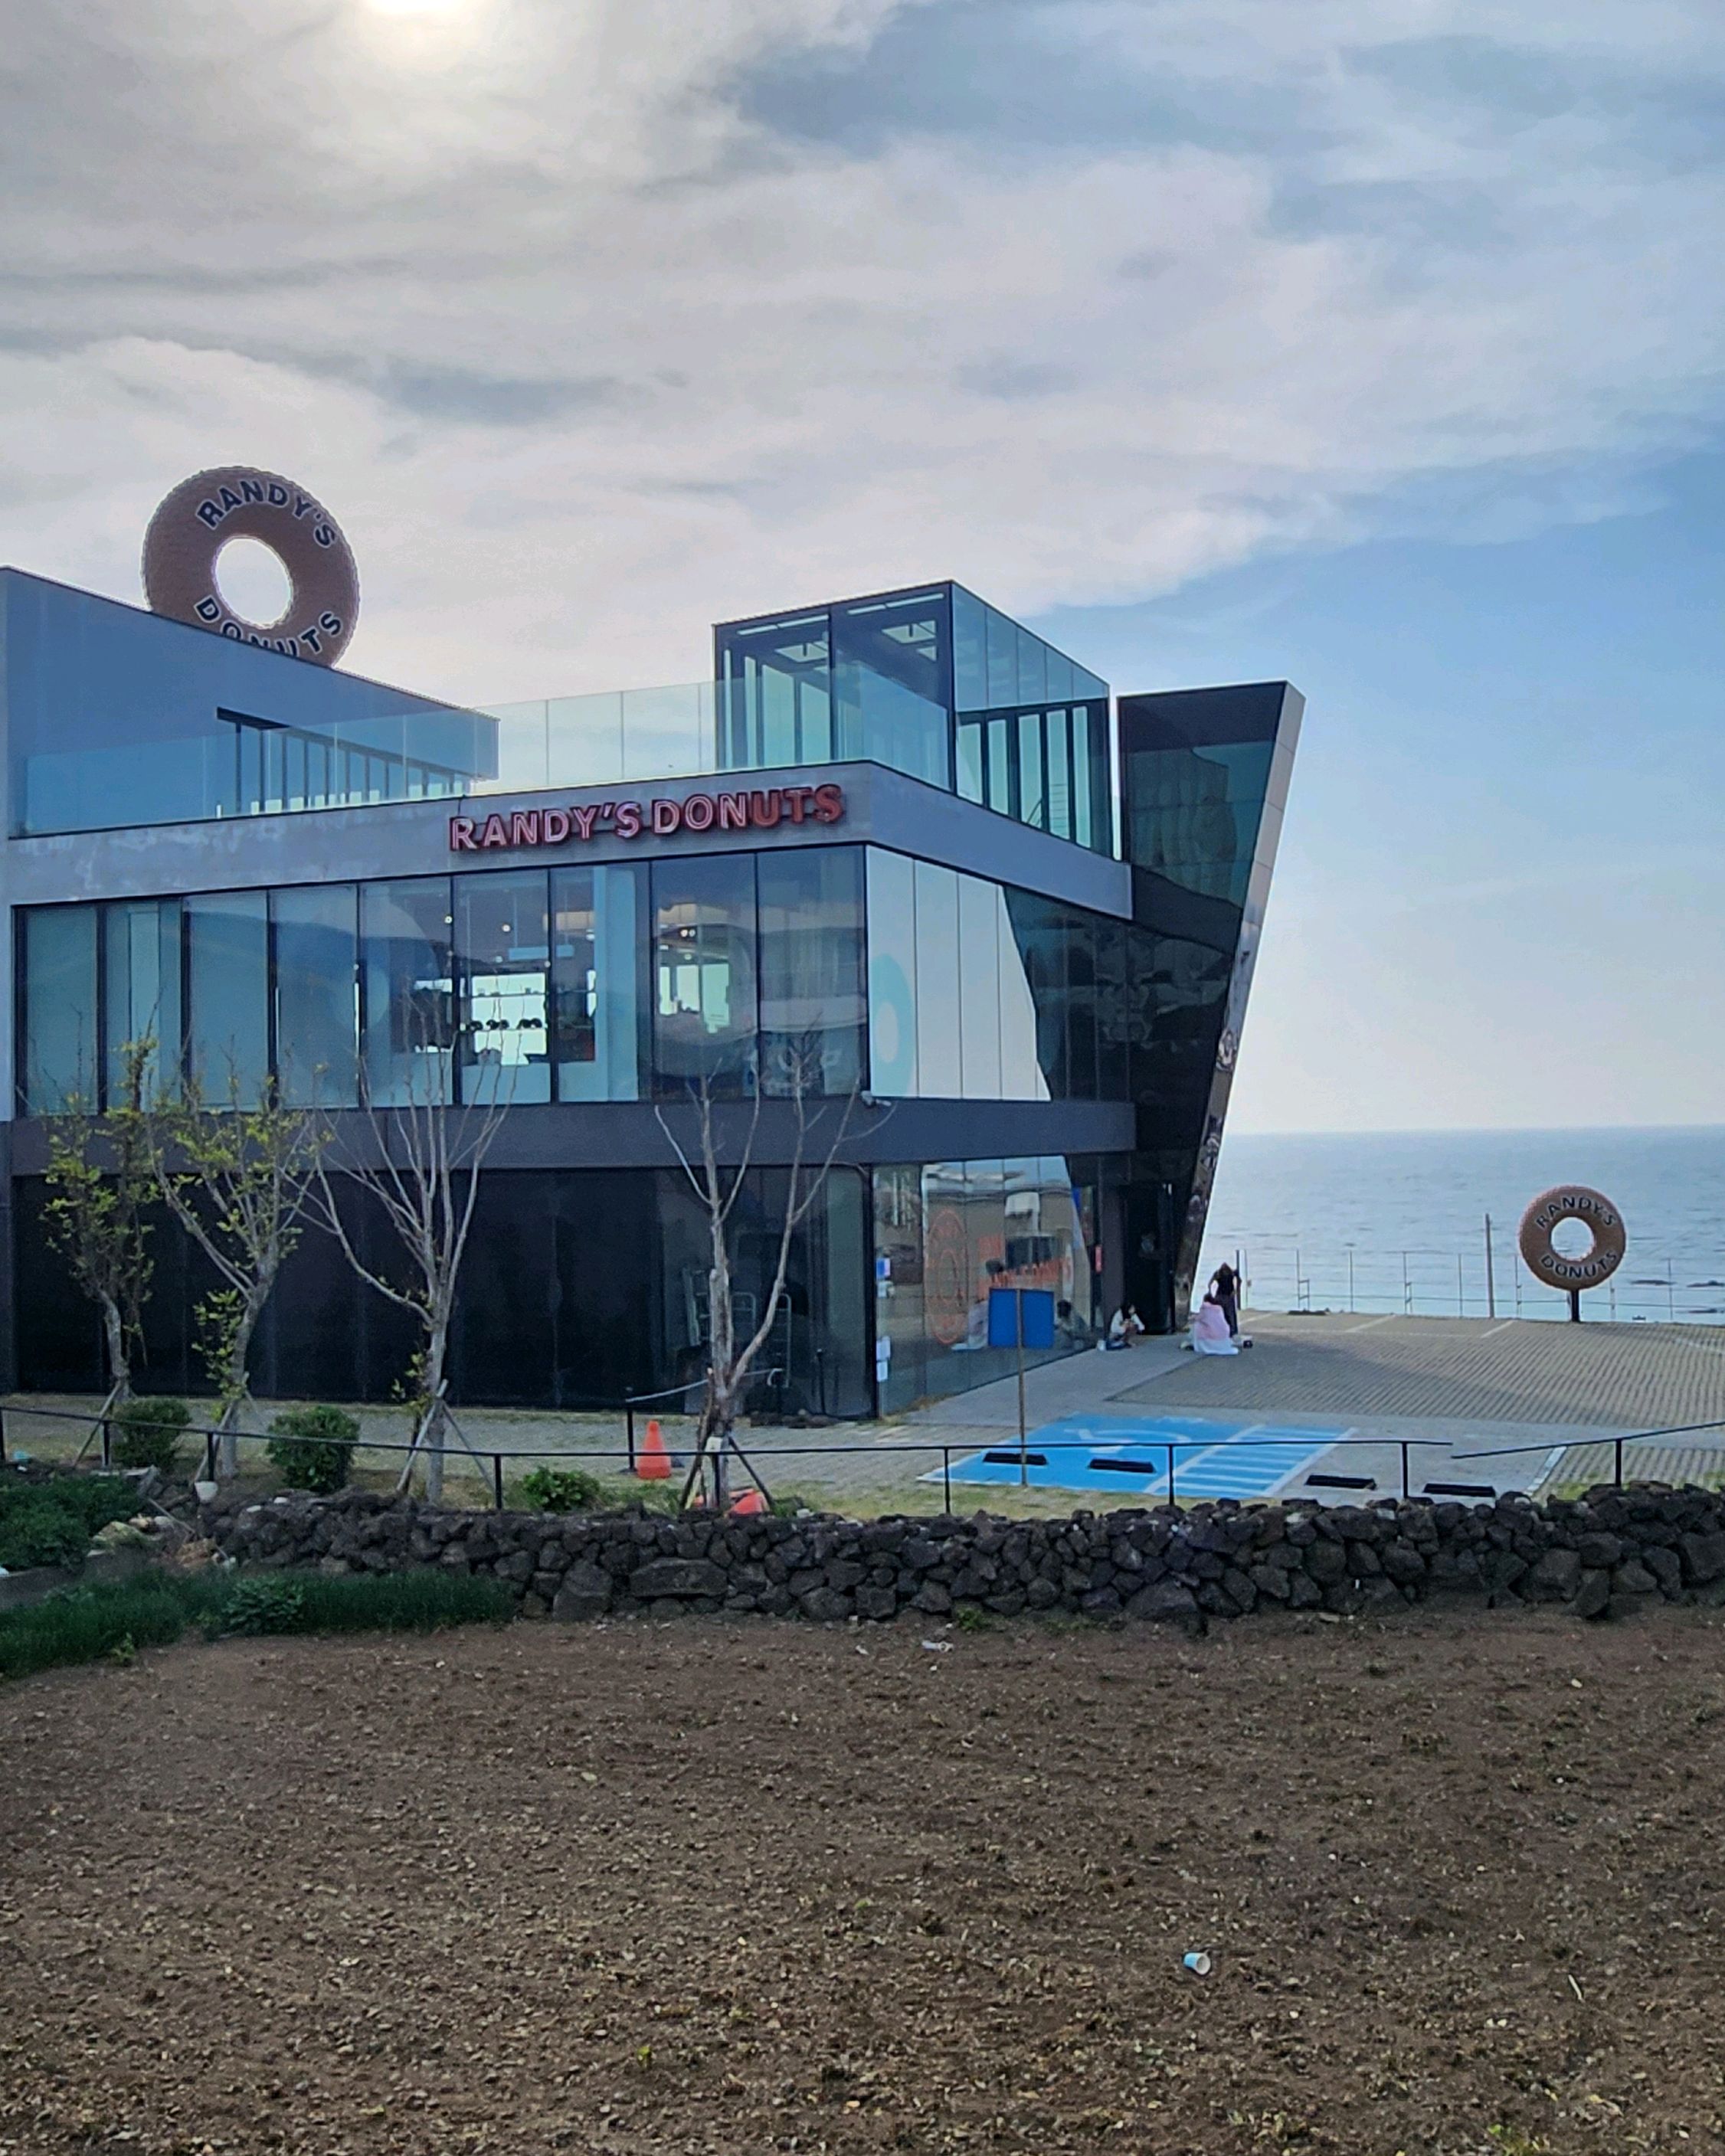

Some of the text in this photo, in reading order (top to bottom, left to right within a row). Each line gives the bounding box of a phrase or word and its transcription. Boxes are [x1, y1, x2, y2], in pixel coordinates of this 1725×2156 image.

[196, 479, 336, 548] RANDY'S
[450, 783, 845, 850] RANDY'S DONUTS
[1540, 1251, 1617, 1278] DONUTS
